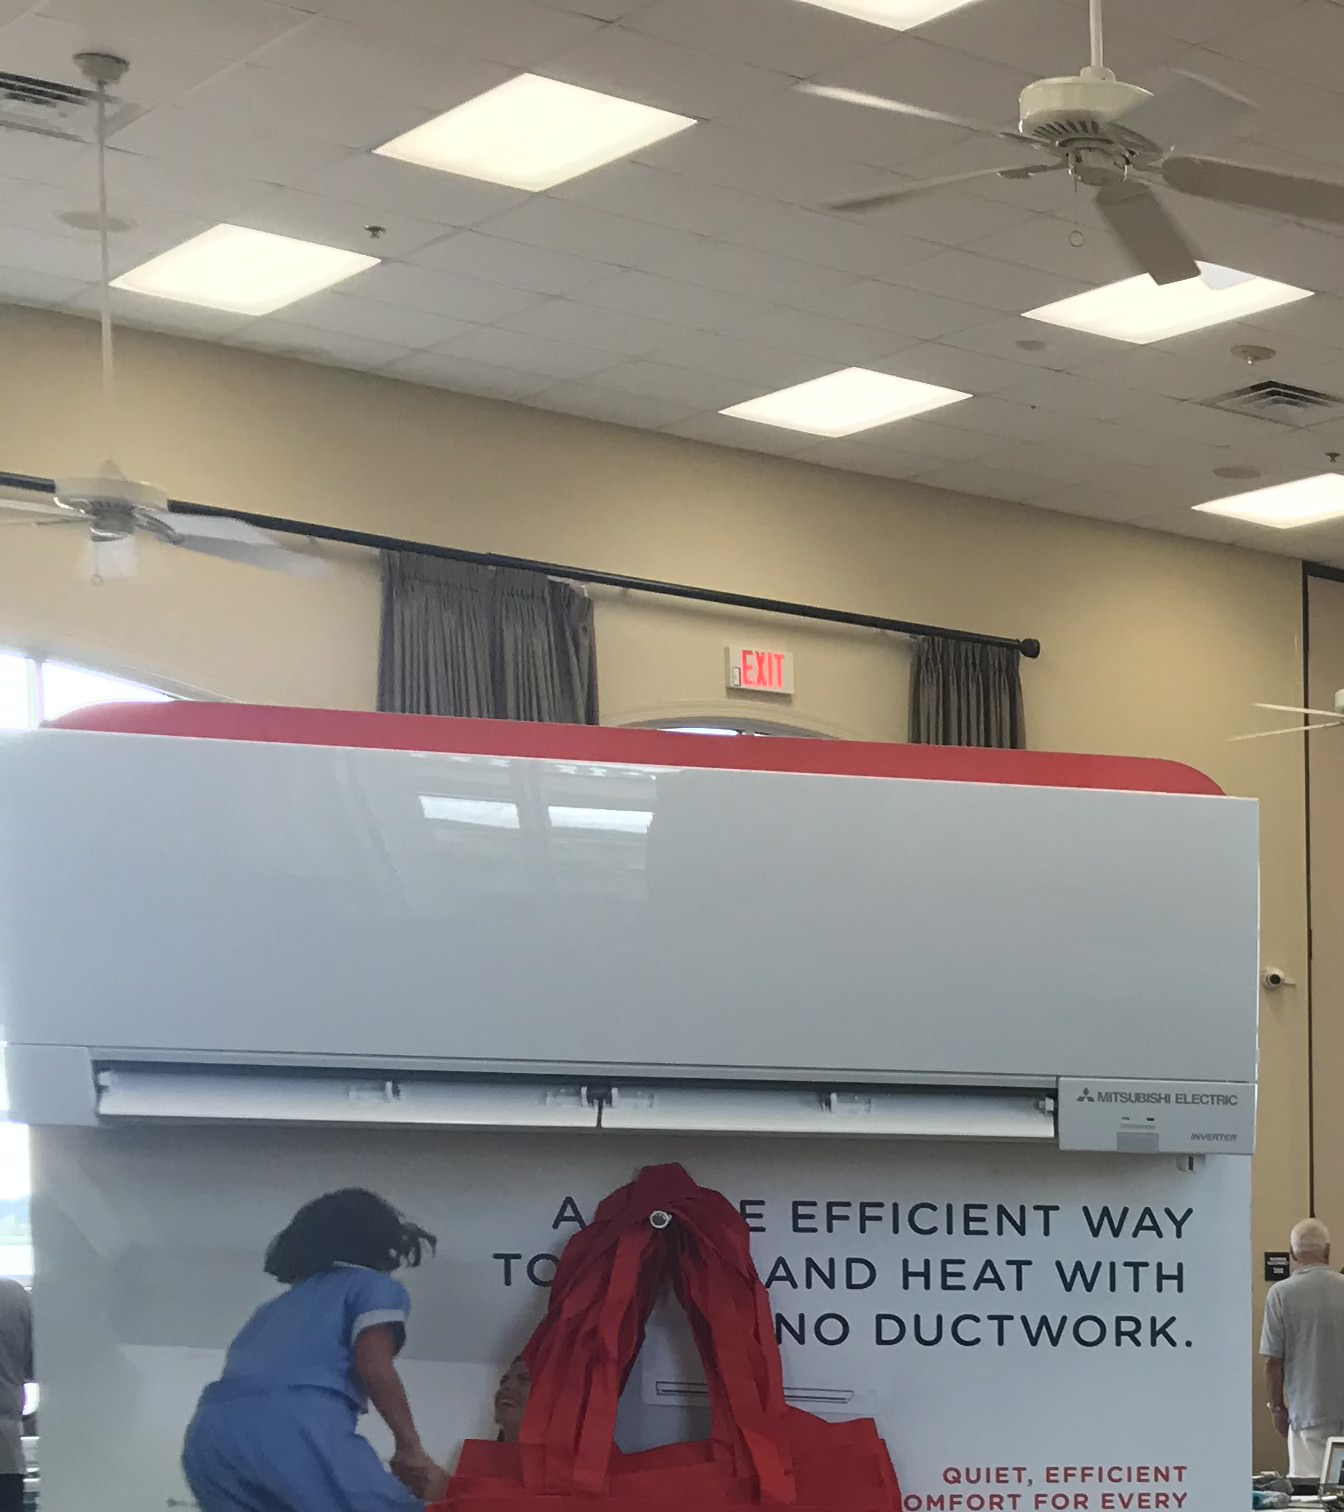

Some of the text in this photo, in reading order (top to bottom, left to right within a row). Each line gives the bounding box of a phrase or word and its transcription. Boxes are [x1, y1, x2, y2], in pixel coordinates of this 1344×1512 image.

[741, 649, 784, 689] EXIT
[1097, 1091, 1239, 1106] MITSUBISHI ELECTRIC
[1190, 1132, 1238, 1142] INVERTER
[552, 1196, 588, 1230] A
[791, 1200, 1060, 1238] EFFICIENT
[1082, 1207, 1194, 1240] WAY
[492, 1253, 1185, 1293] TO AND HEAT WITH
[775, 1312, 1193, 1349] NO DUCTWORK.
[942, 1465, 1188, 1487] QUIET, EFFICIENT
[1034, 1492, 1189, 1511] FOR EVERY
